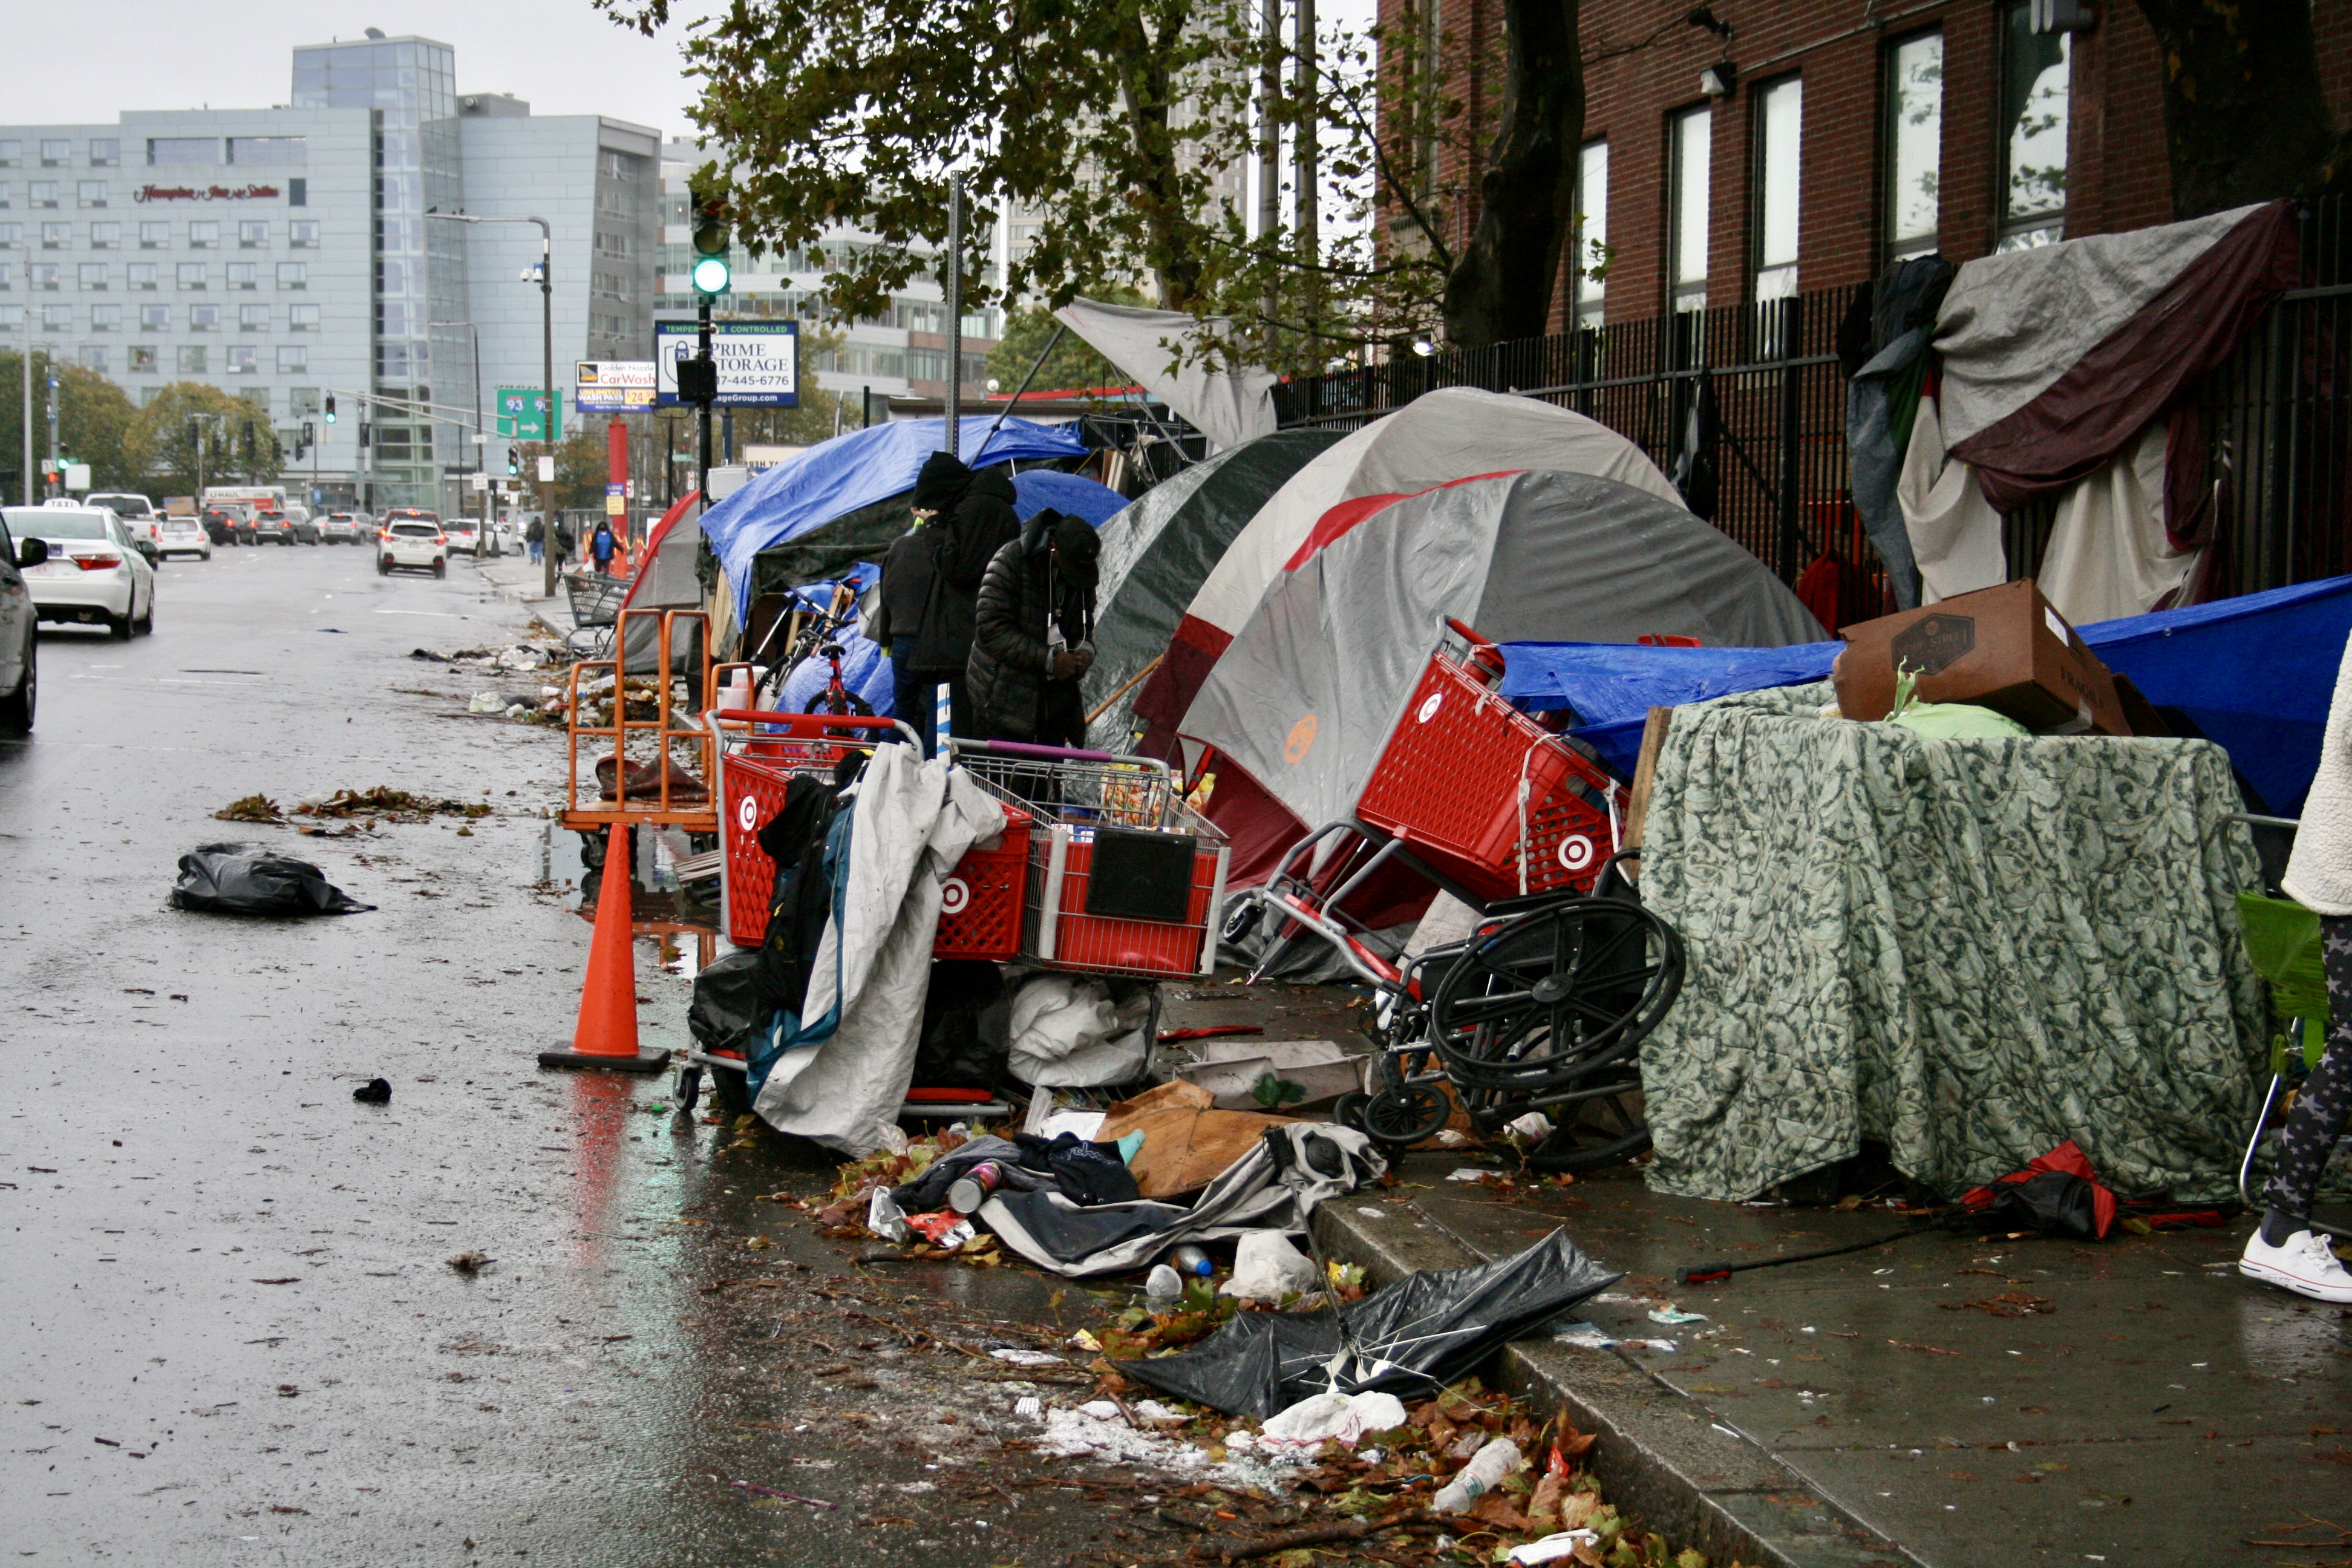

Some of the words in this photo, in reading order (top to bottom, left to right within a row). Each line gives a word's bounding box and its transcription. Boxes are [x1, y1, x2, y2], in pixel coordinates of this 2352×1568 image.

[134, 185, 200, 203] Hampton
[201, 185, 234, 200] Inn
[243, 184, 279, 198] Suites
[711, 343, 766, 356] PRIME
[601, 373, 656, 384] CarWash
[717, 376, 789, 385] 17-445-6776
[507, 400, 523, 411] 93
